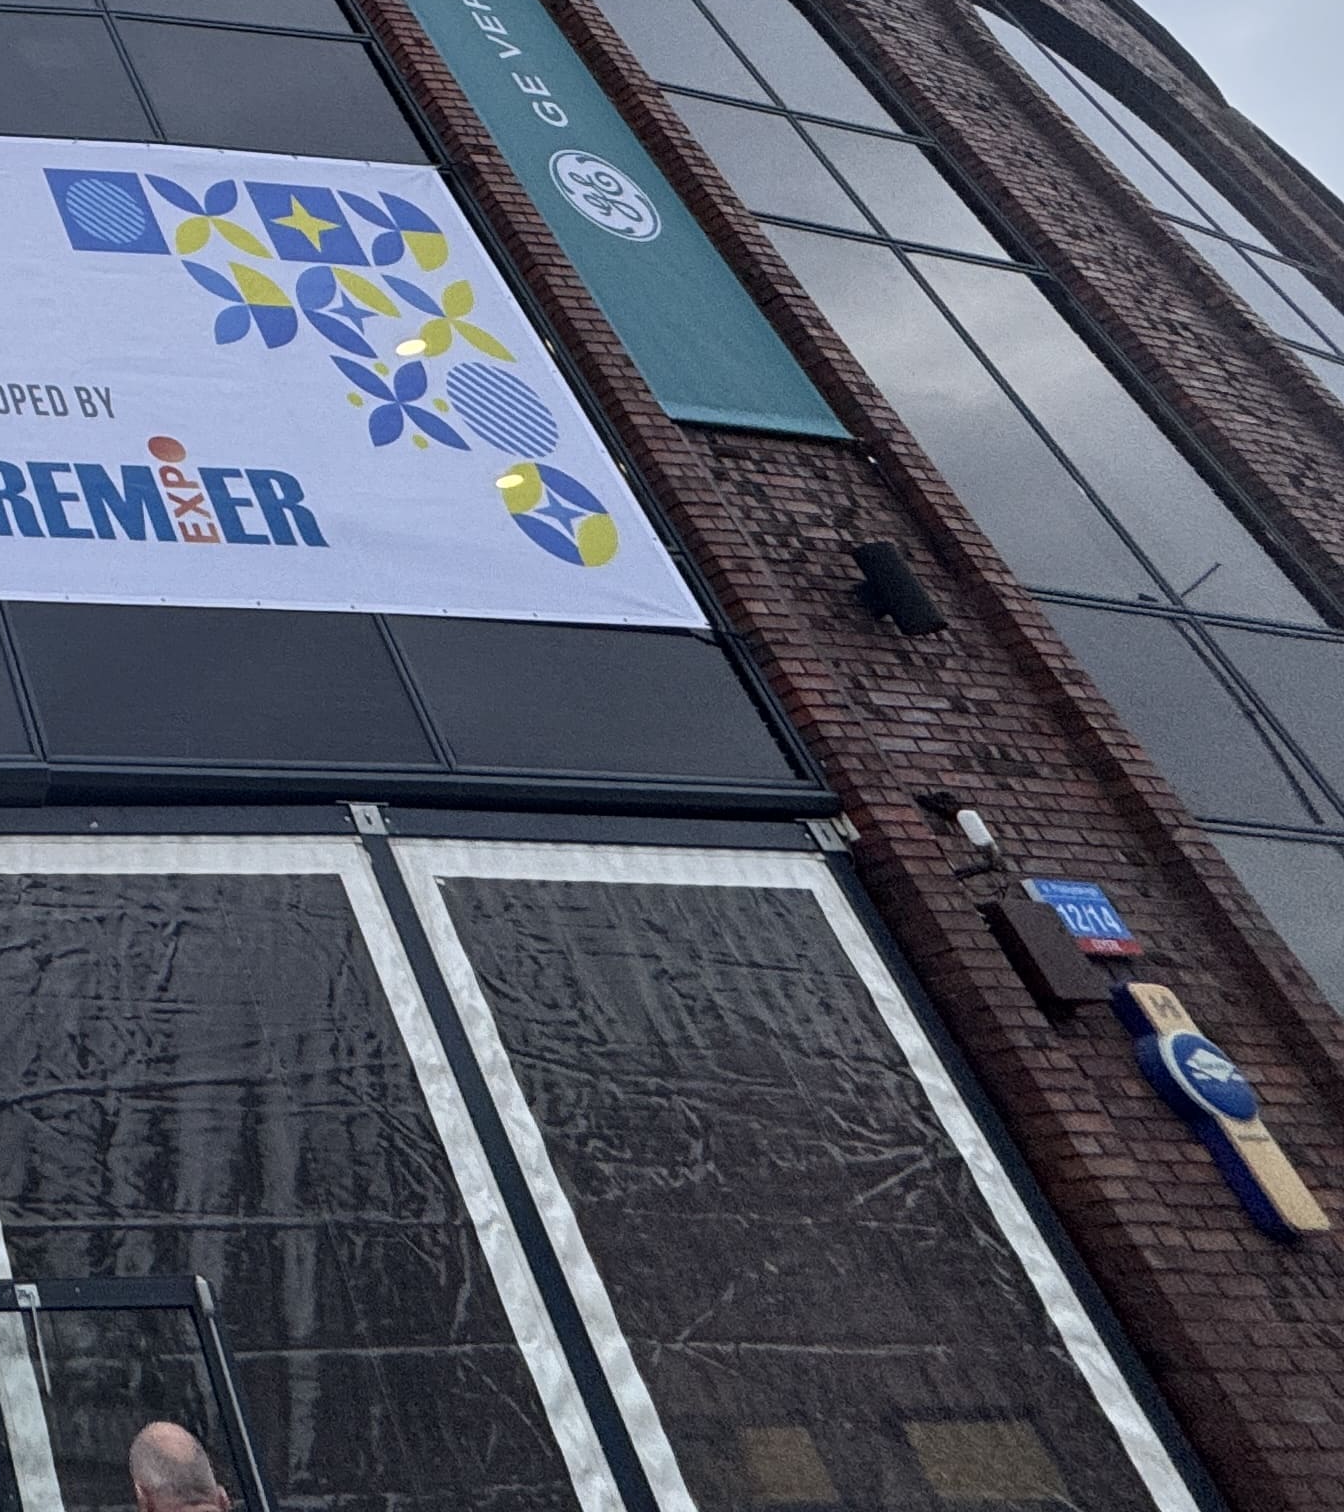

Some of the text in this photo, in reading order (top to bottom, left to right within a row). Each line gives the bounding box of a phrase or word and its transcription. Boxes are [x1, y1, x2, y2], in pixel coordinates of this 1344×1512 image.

[512, 72, 569, 128] GE
[75, 385, 117, 421] BY
[1056, 902, 1123, 934] 12/14
